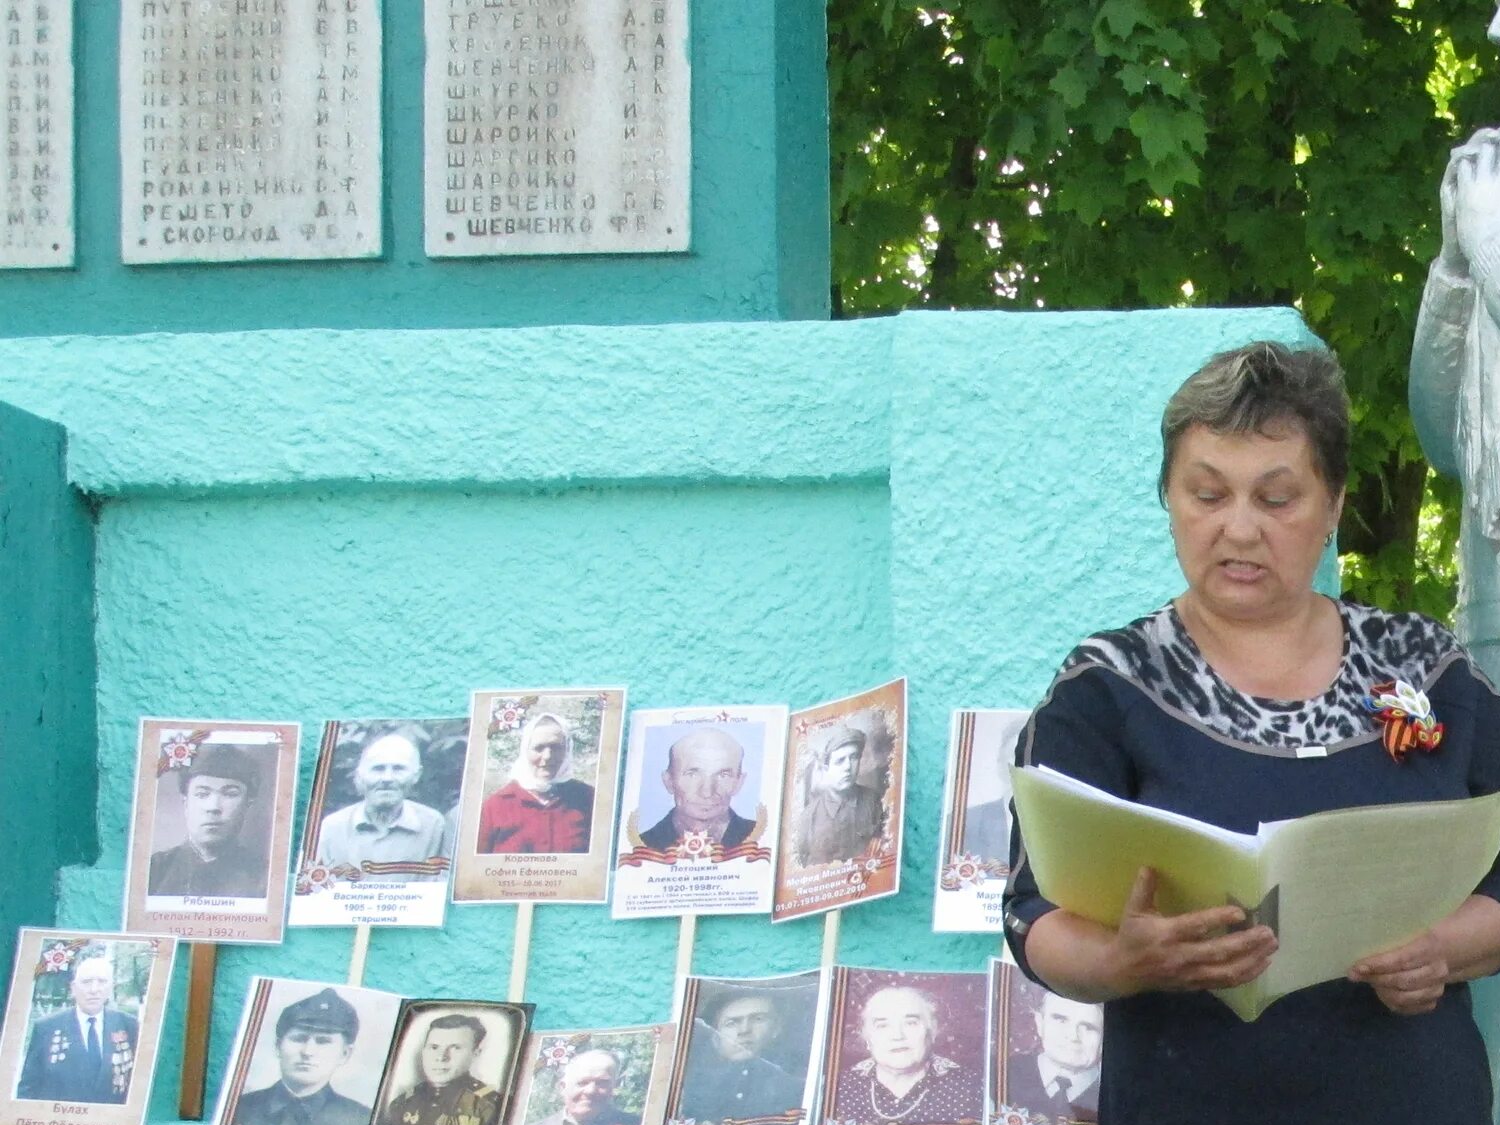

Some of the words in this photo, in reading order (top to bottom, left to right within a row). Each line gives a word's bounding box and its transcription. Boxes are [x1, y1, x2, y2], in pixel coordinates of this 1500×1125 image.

[445, 194, 597, 215] ШЕВЧЕНКО
[142, 202, 254, 222] РЕШЕТО
[467, 217, 594, 237] ШЕВЧЕНКО
[484, 867, 518, 878] София
[670, 864, 719, 874] Потоцкий
[647, 874, 690, 884] Алексей
[692, 873, 741, 882] иванович
[183, 895, 236, 907] Рябишин
[333, 893, 376, 901] Василий
[377, 893, 423, 902] Егорович
[976, 891, 1003, 900] Март
[152, 912, 191, 922] Степан
[193, 912, 269, 923] Максимович
[351, 915, 398, 924] старшина
[985, 915, 1003, 924] тру
[168, 926, 194, 937] 1912
[207, 927, 235, 938] 1992
